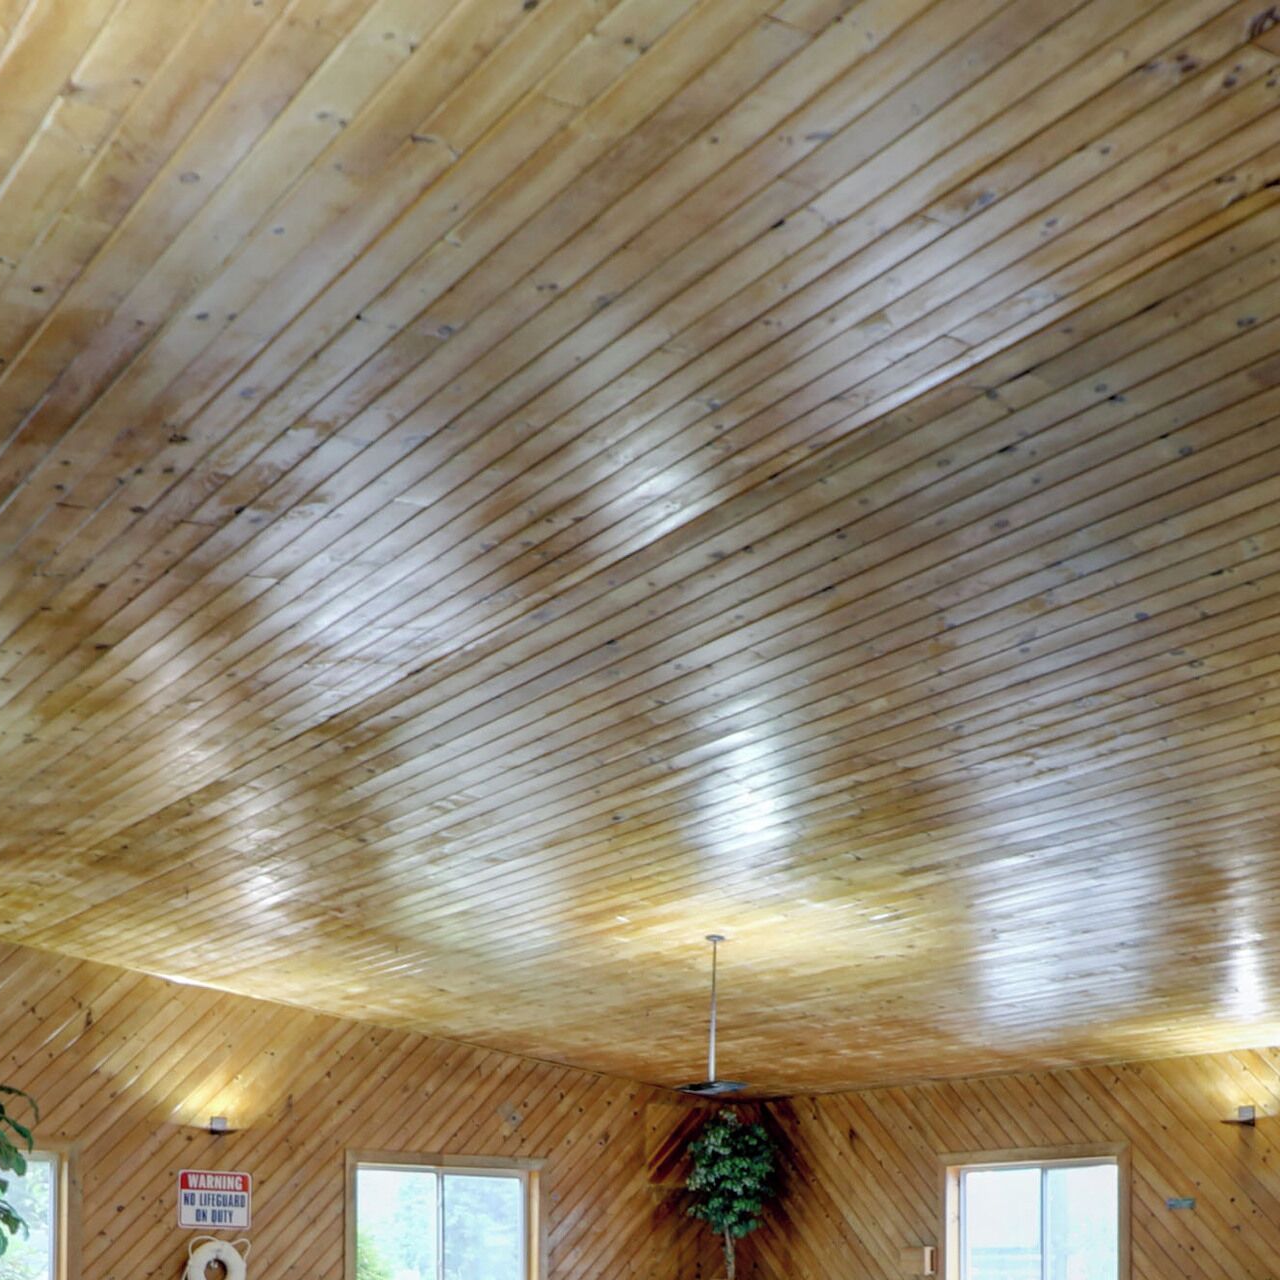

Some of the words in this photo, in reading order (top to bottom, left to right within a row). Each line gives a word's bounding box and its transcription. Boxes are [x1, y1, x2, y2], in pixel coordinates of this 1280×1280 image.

[188, 1174, 243, 1190] WARNING
[184, 1193, 195, 1206] NO
[199, 1193, 246, 1208] LIFEGUARD
[195, 1209, 207, 1222] ON
[211, 1209, 233, 1223] DUTY
